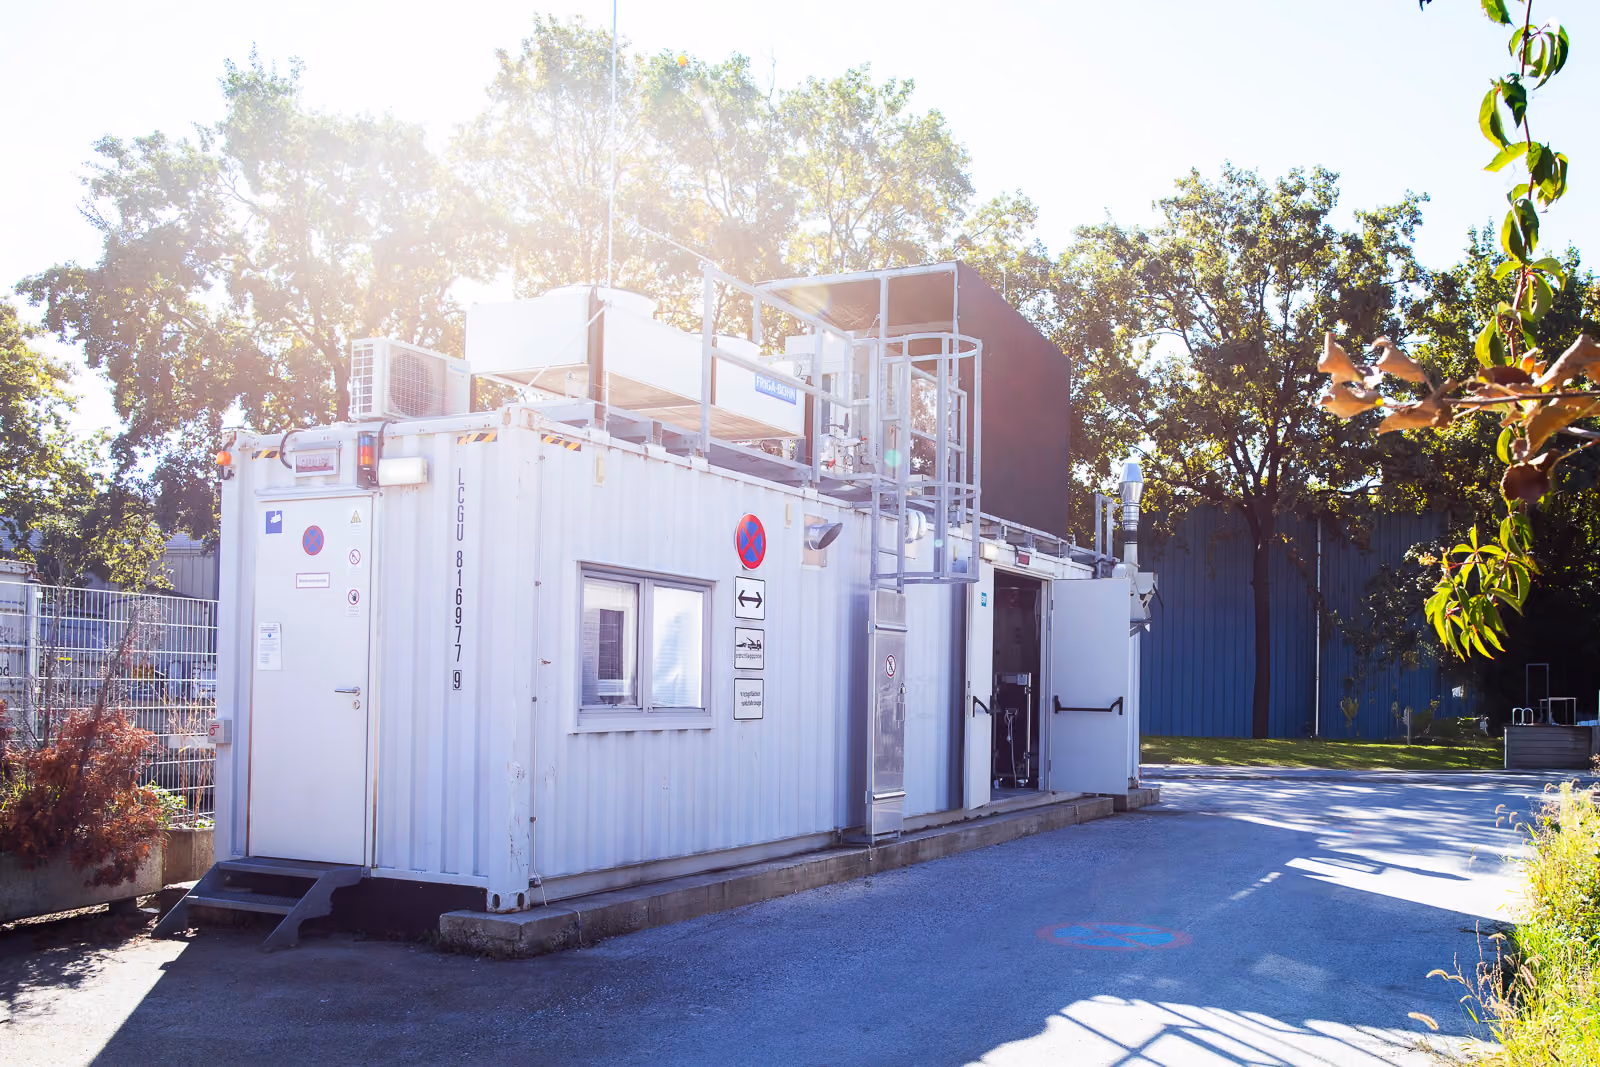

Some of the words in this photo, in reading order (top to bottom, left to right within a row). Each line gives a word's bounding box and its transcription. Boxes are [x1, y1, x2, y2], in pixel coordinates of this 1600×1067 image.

[756, 375, 796, 401] FRIGA-BOHN
[456, 468, 465, 541] LCGU
[454, 550, 463, 662] 816977
[453, 671, 461, 689] 9
